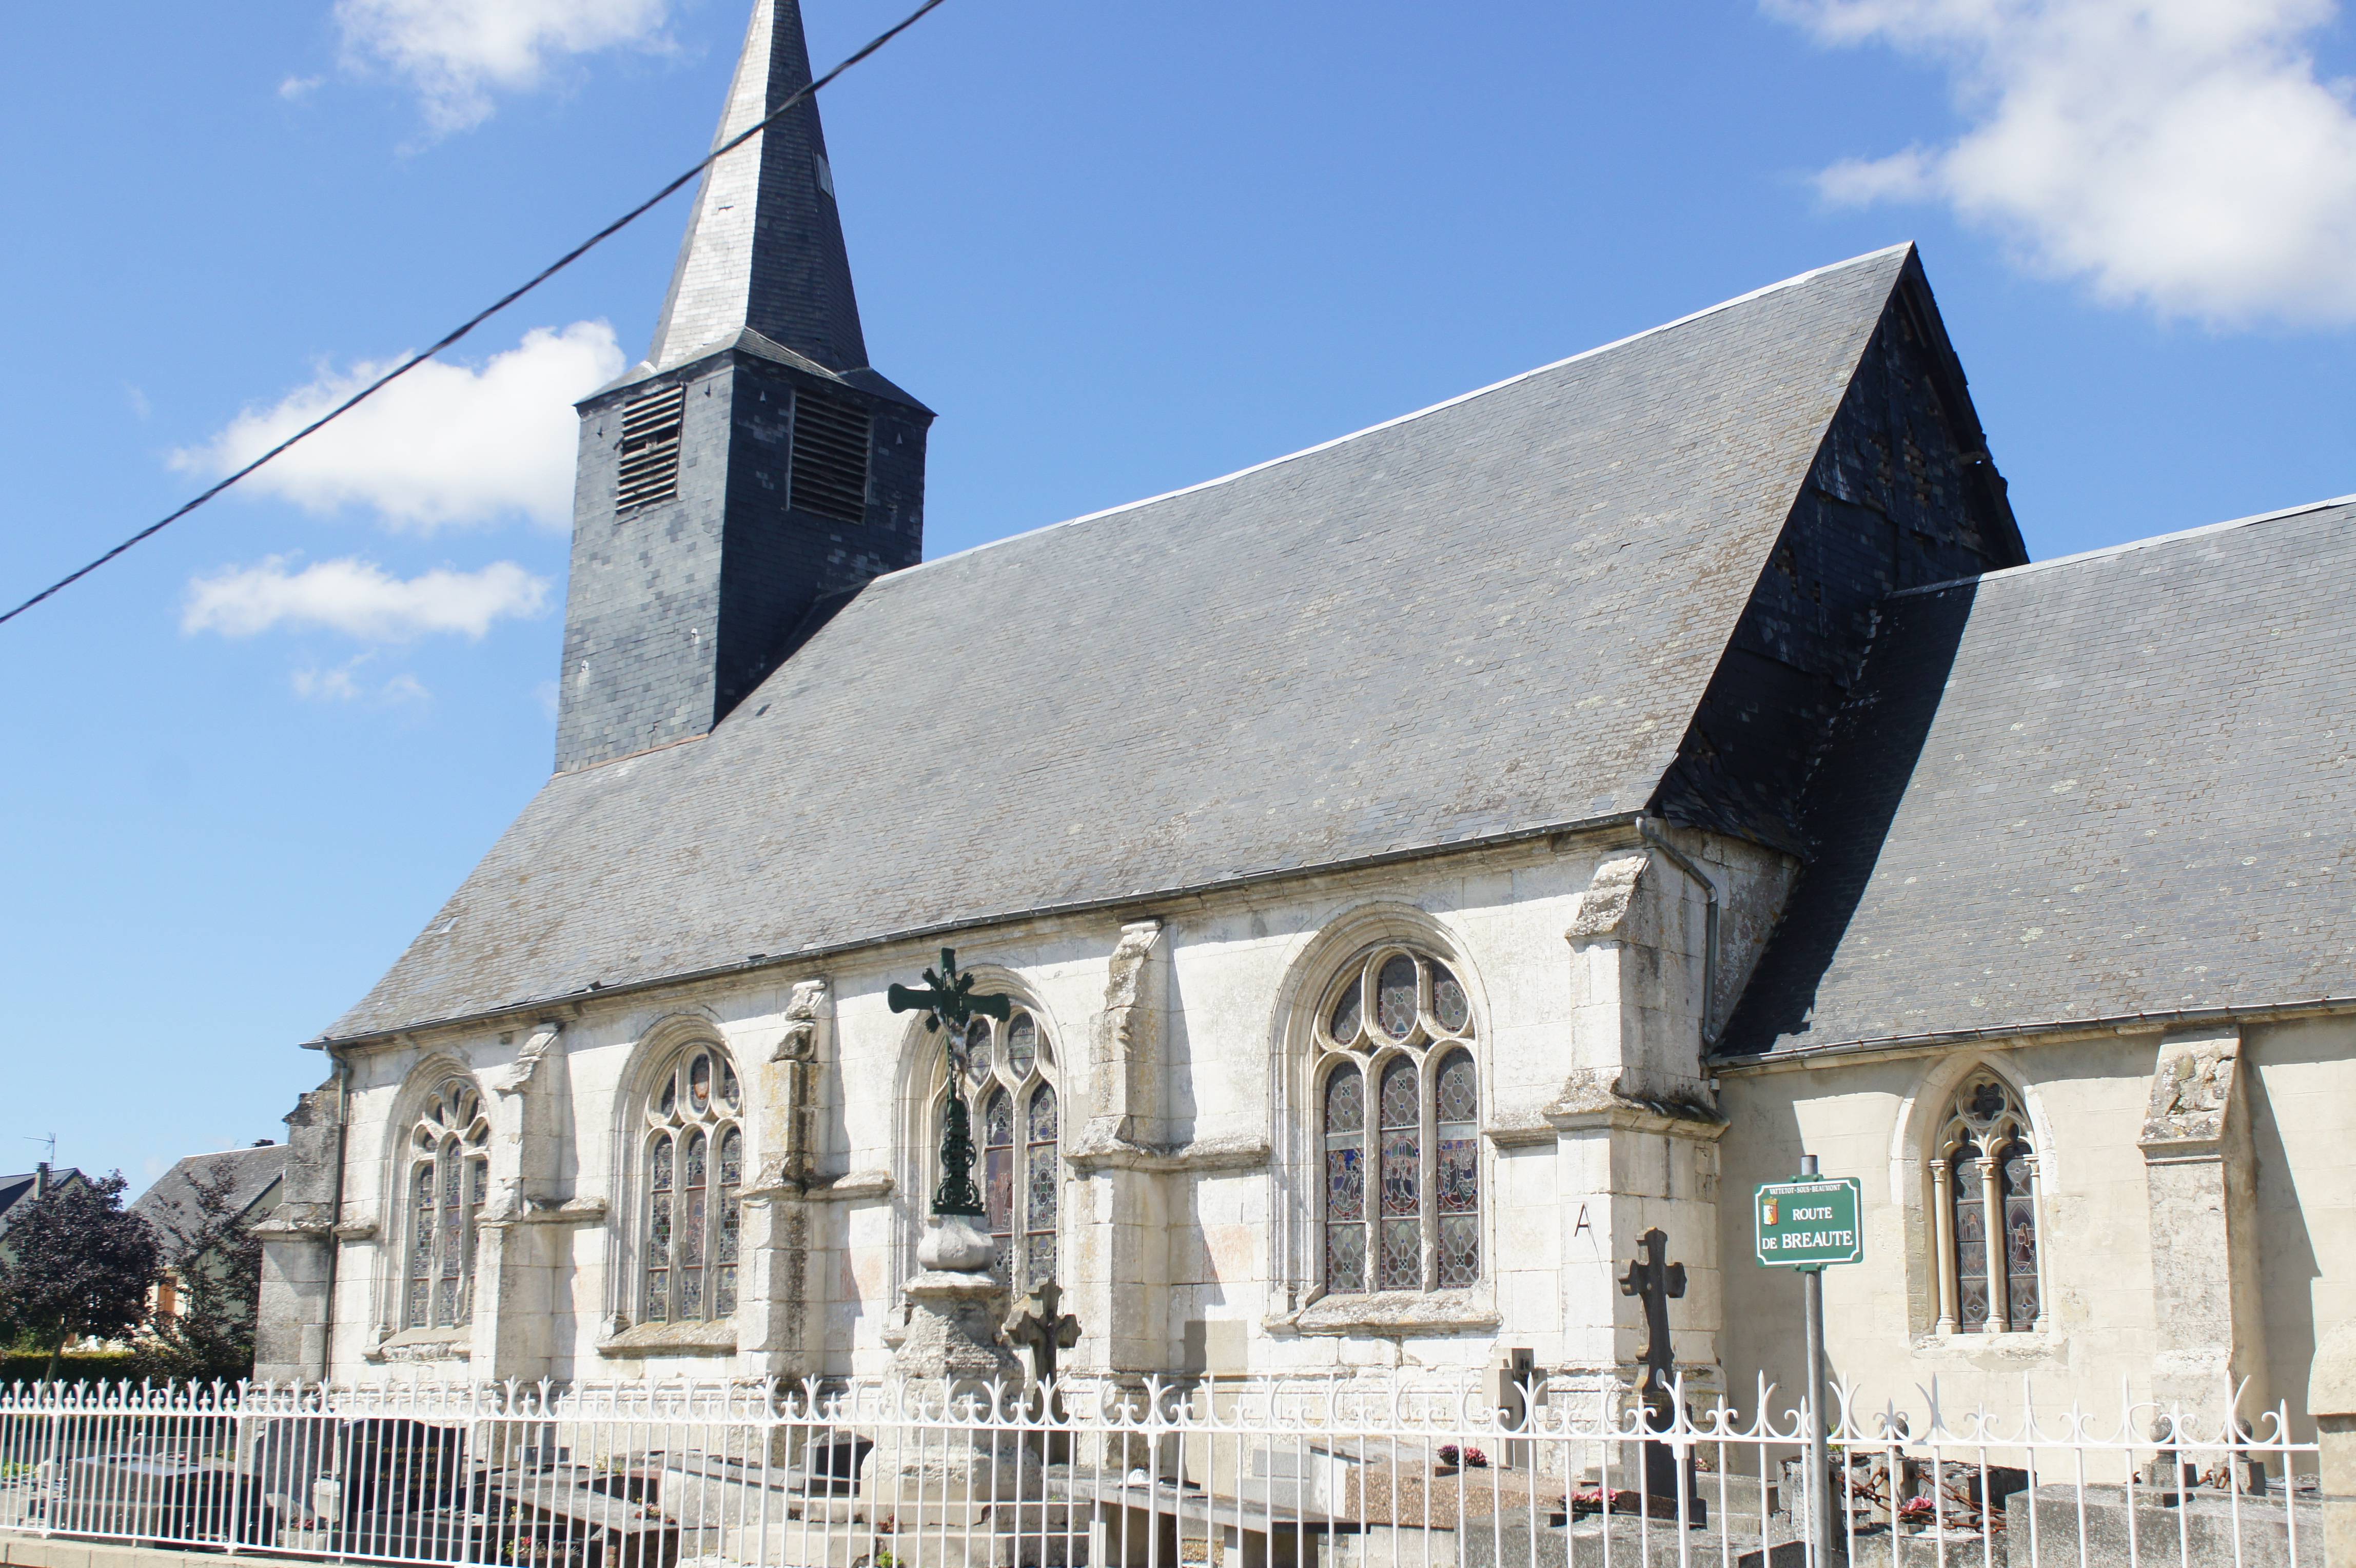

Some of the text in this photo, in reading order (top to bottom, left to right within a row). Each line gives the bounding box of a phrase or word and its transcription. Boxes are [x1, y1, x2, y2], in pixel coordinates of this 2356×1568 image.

[1792, 1207, 1833, 1221] ROUTE
[1762, 1230, 1853, 1249] DE BREAUTE
